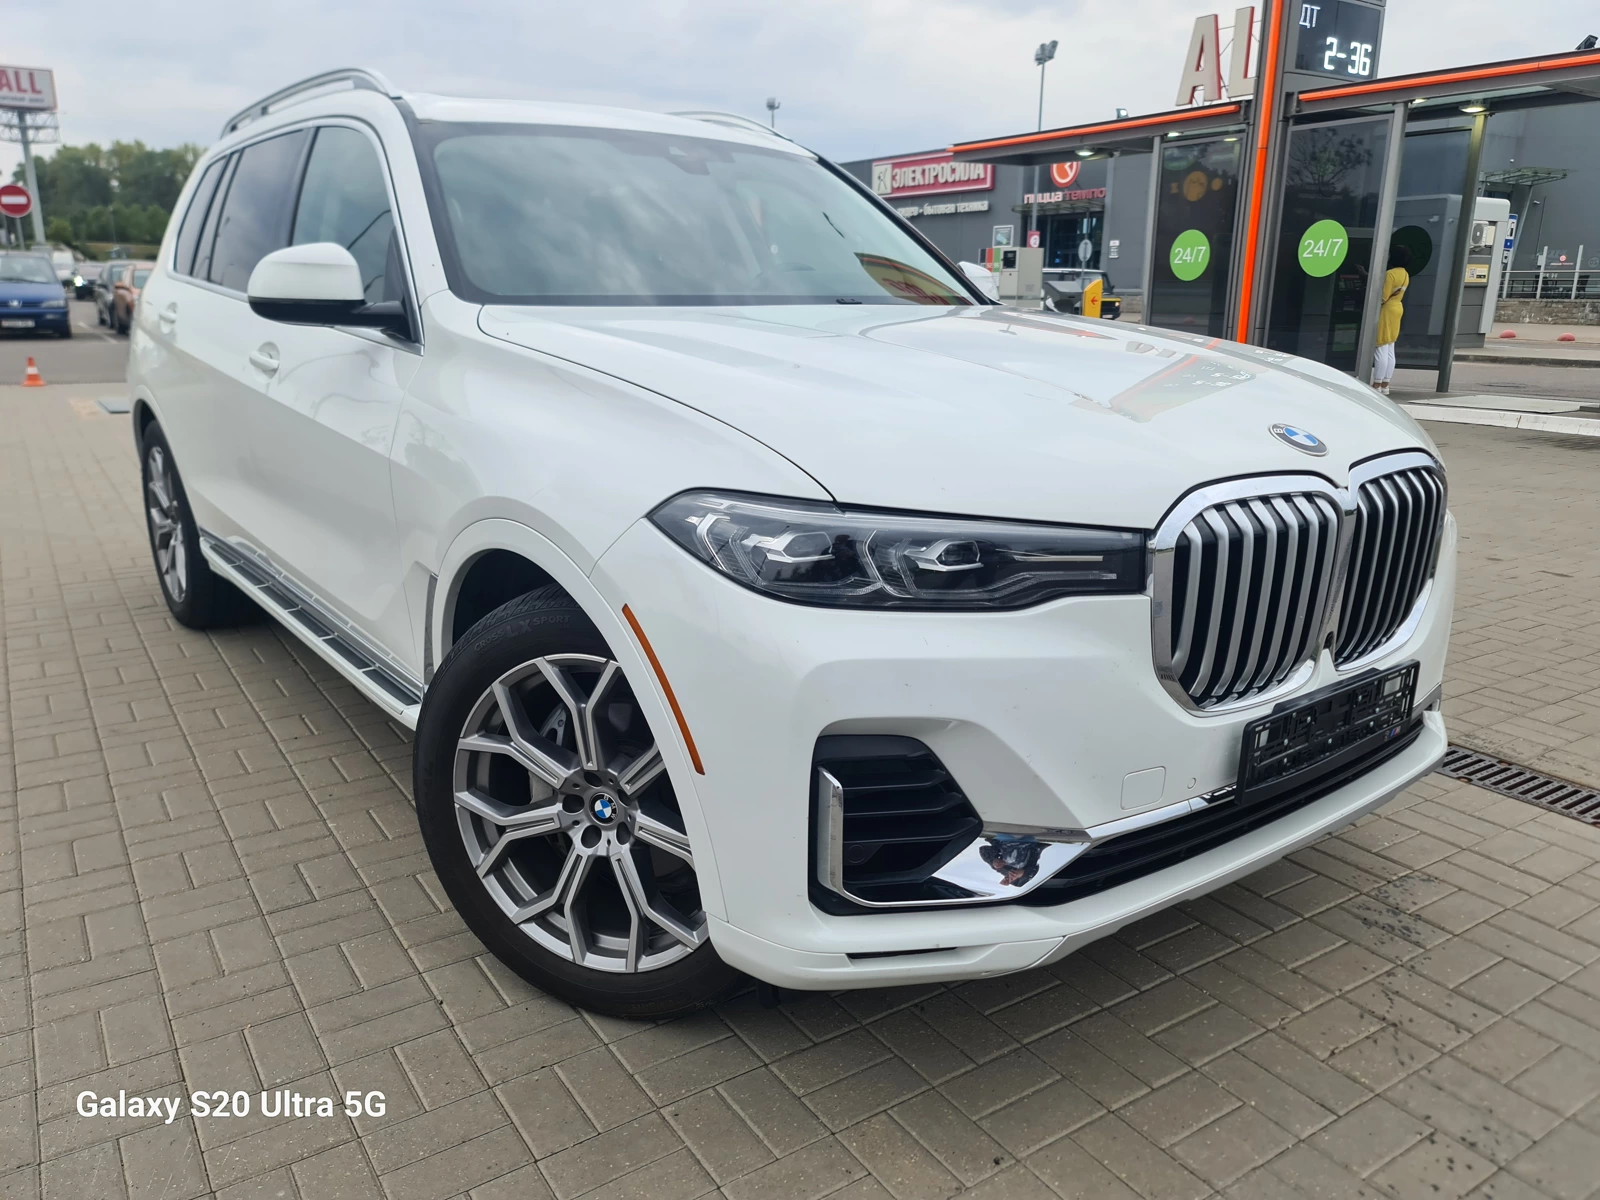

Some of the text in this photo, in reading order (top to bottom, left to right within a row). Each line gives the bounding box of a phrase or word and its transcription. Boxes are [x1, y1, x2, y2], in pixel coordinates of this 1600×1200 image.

[1299, 4, 1321, 29] ДТ
[1323, 36, 1372, 76] 2-36
[892, 162, 985, 188] ЭЛЕКТРОСИЛА
[1173, 246, 1206, 264] 24/7
[1302, 238, 1344, 258] 24/7
[474, 628, 505, 651] CROSS
[533, 614, 571, 626] SPORT
